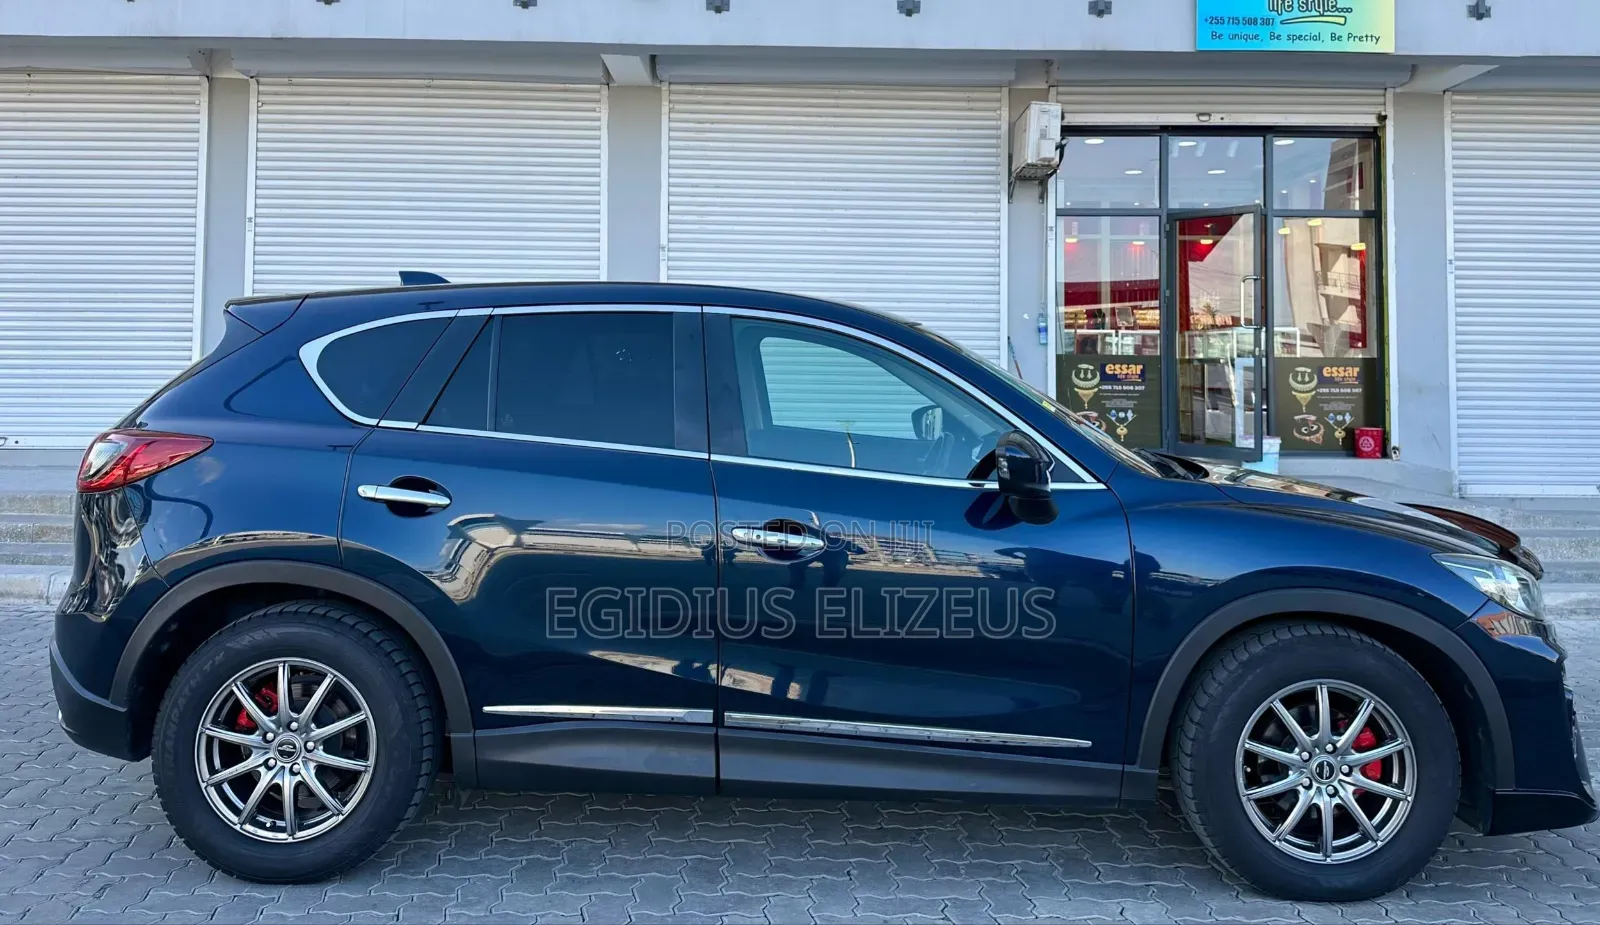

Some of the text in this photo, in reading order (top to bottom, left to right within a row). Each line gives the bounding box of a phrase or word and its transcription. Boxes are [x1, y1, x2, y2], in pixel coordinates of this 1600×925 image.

[1204, 17, 1275, 27] +255 715 508 307
[1211, 31, 1381, 45] Be unique, Be special, Be Pretty
[1105, 363, 1144, 375] essar
[1322, 366, 1359, 377] essar
